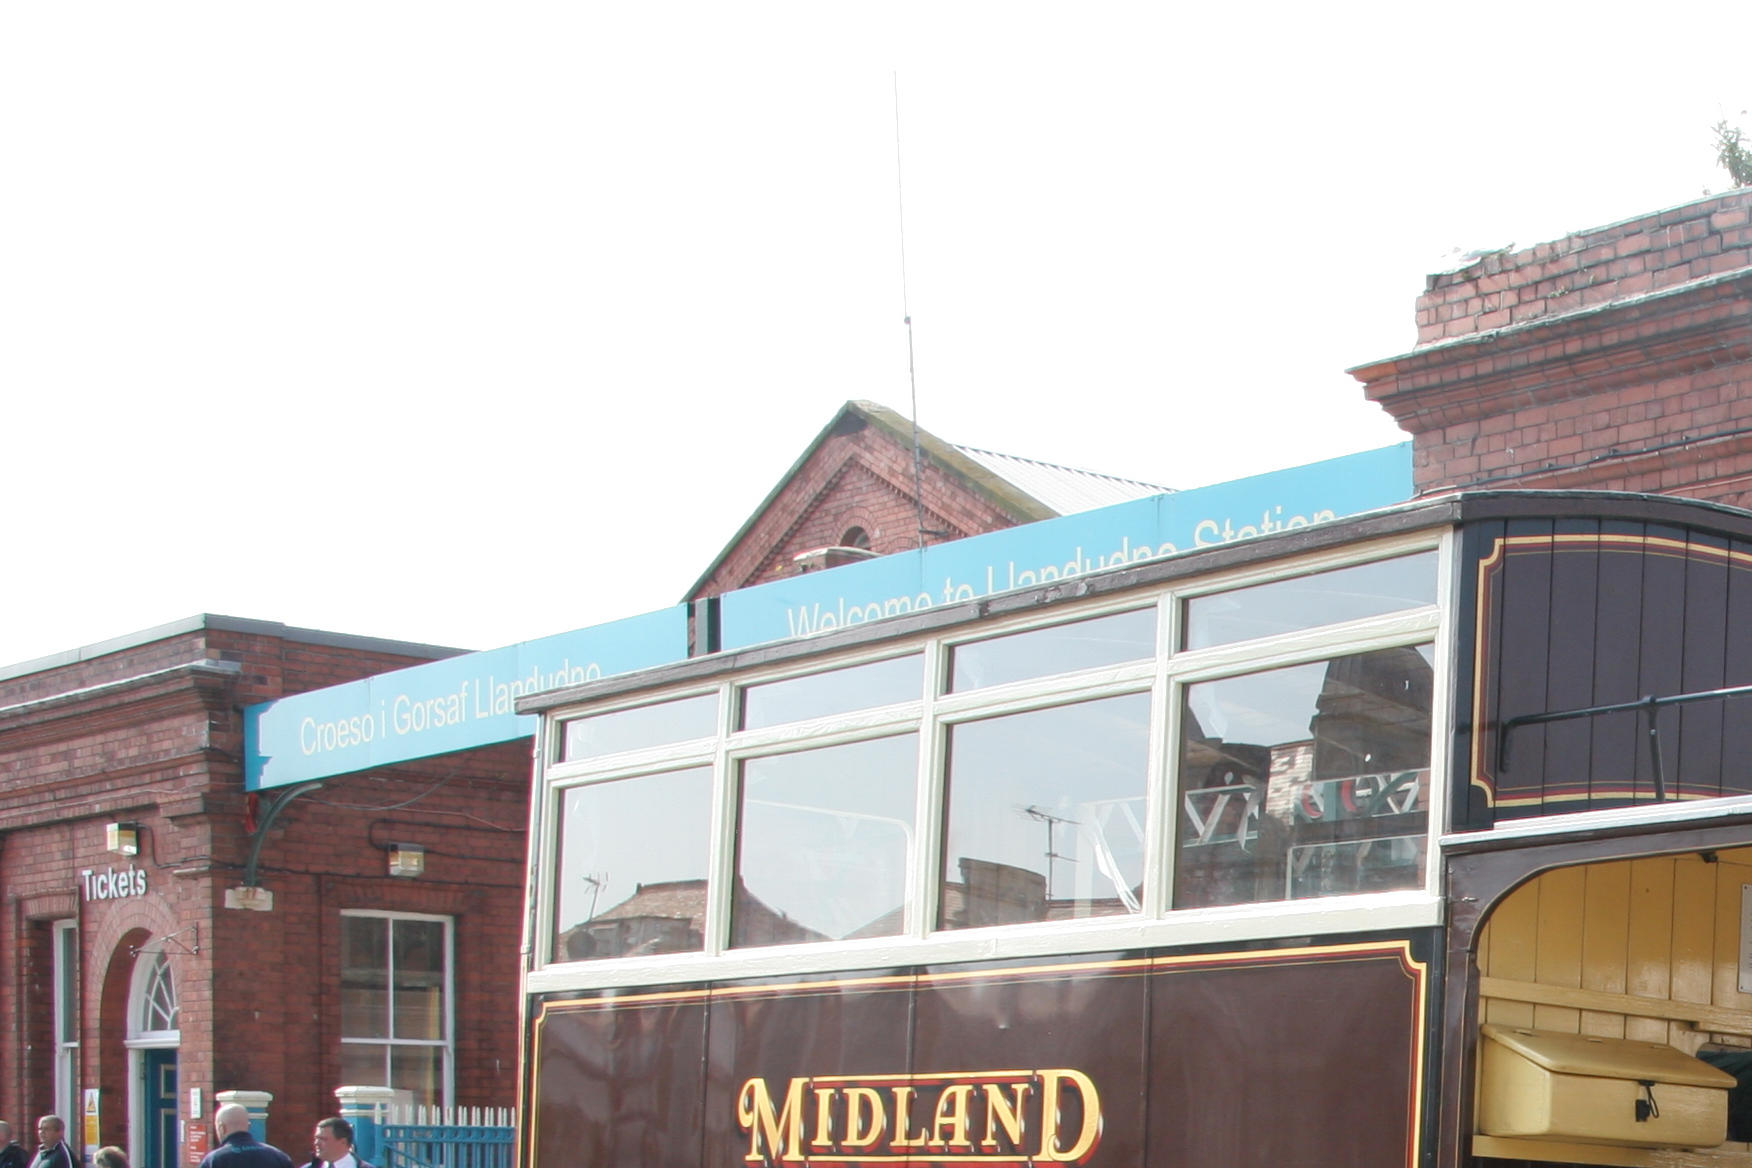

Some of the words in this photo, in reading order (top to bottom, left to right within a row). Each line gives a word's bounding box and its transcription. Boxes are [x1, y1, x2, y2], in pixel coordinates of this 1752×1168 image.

[300, 714, 375, 756] Croeso
[380, 700, 387, 739] i
[393, 680, 469, 736] Gorsaf
[82, 864, 147, 901] Tickets
[738, 1068, 1102, 1163] MIDLAND
